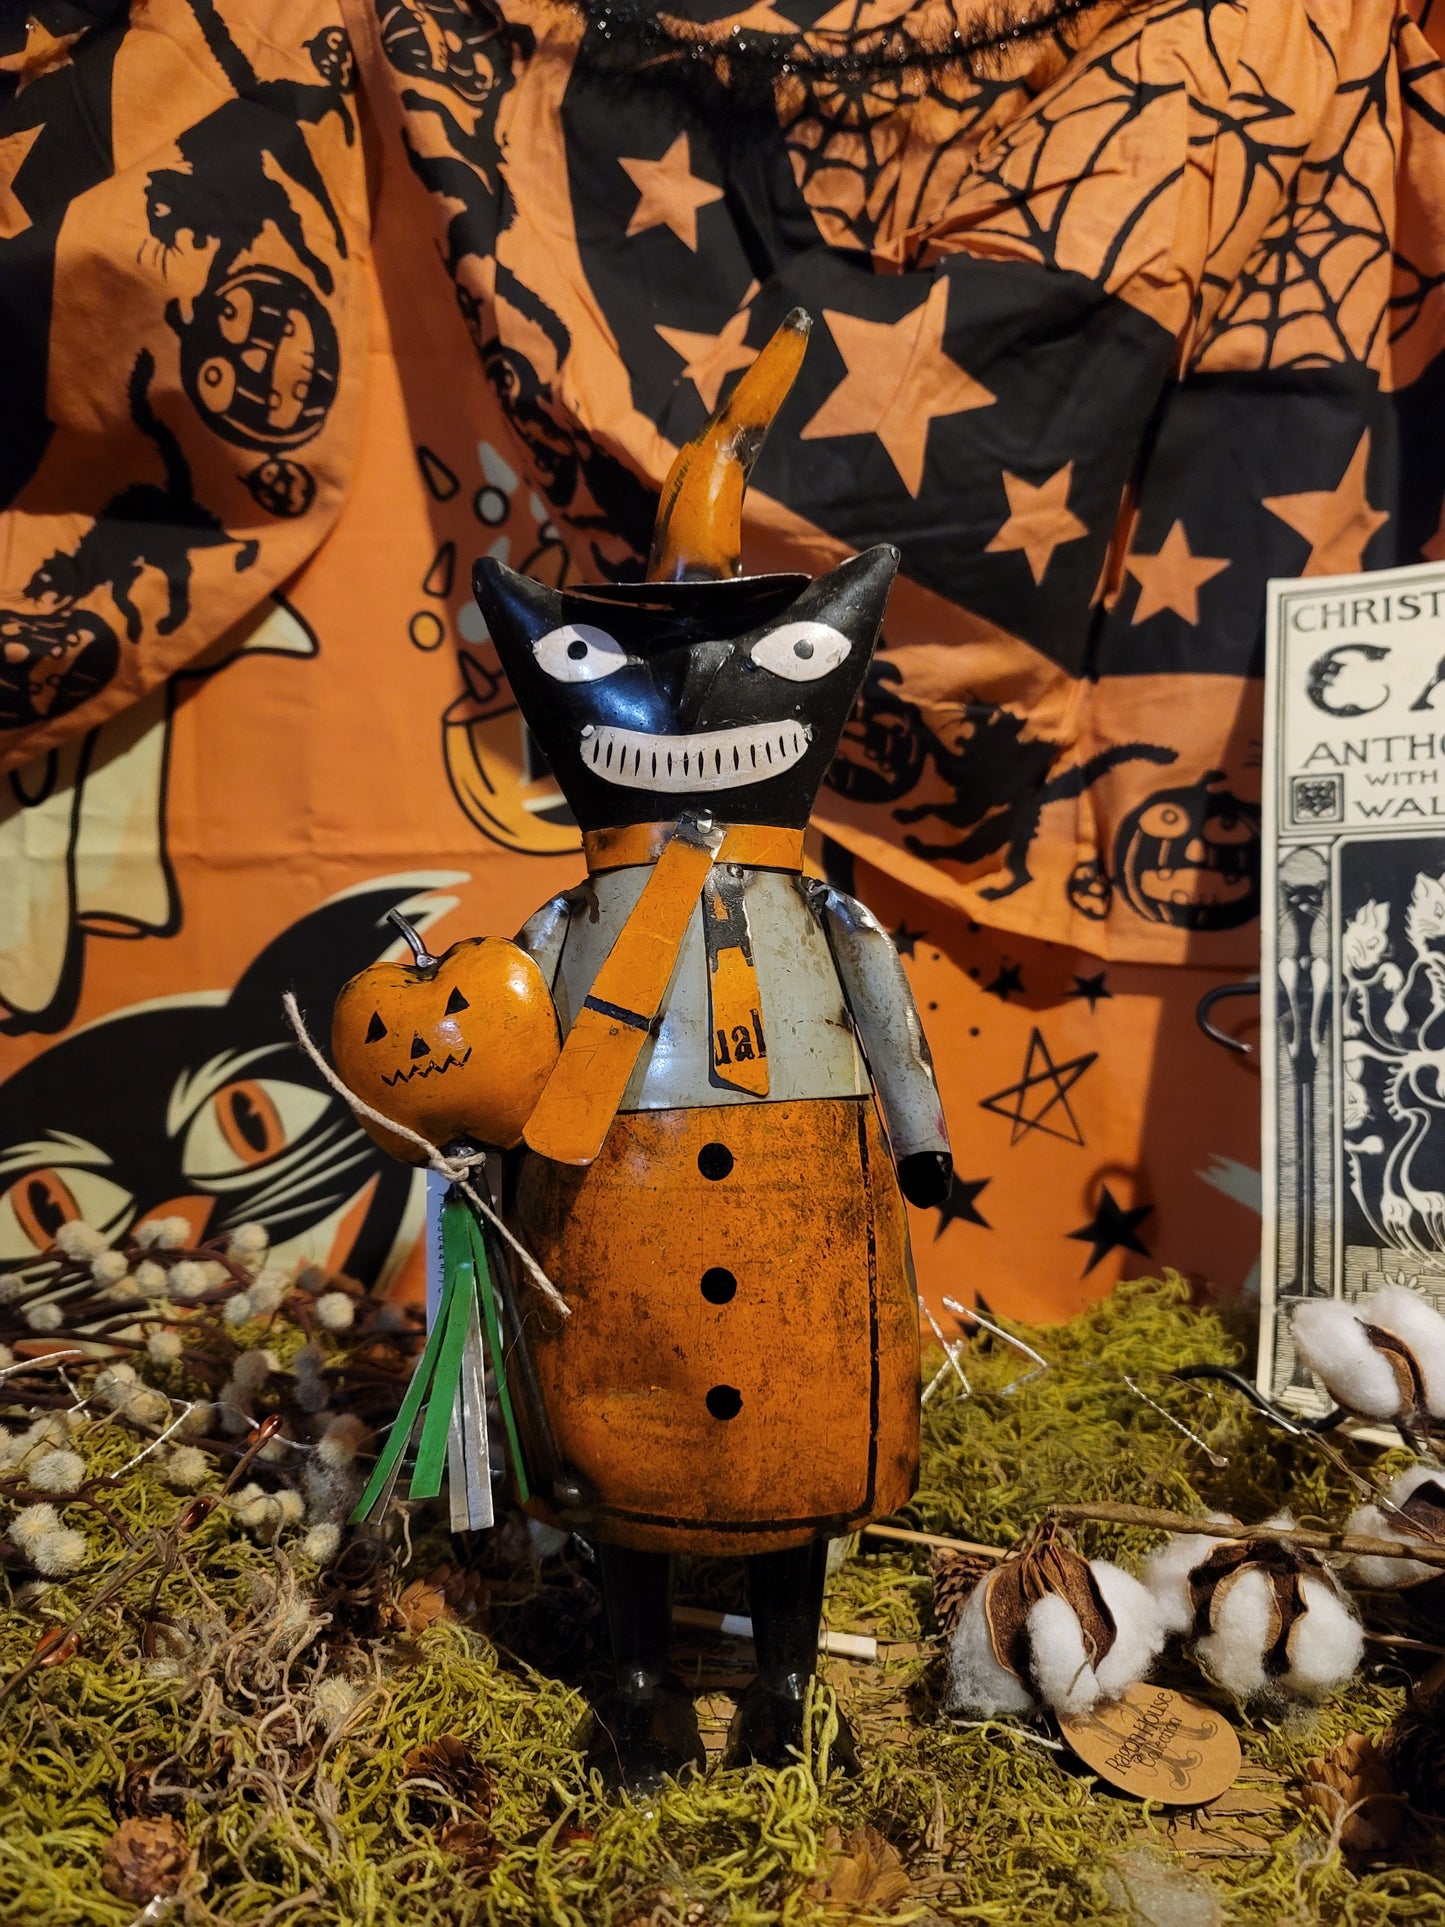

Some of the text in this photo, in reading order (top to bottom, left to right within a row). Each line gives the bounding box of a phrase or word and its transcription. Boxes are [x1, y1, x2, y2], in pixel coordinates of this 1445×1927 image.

[1302, 733, 1445, 769] ANTH
[1364, 769, 1438, 787] WITH
[1105, 1692, 1173, 1775] Ragon House
[1133, 1716, 1183, 1769] Collection
